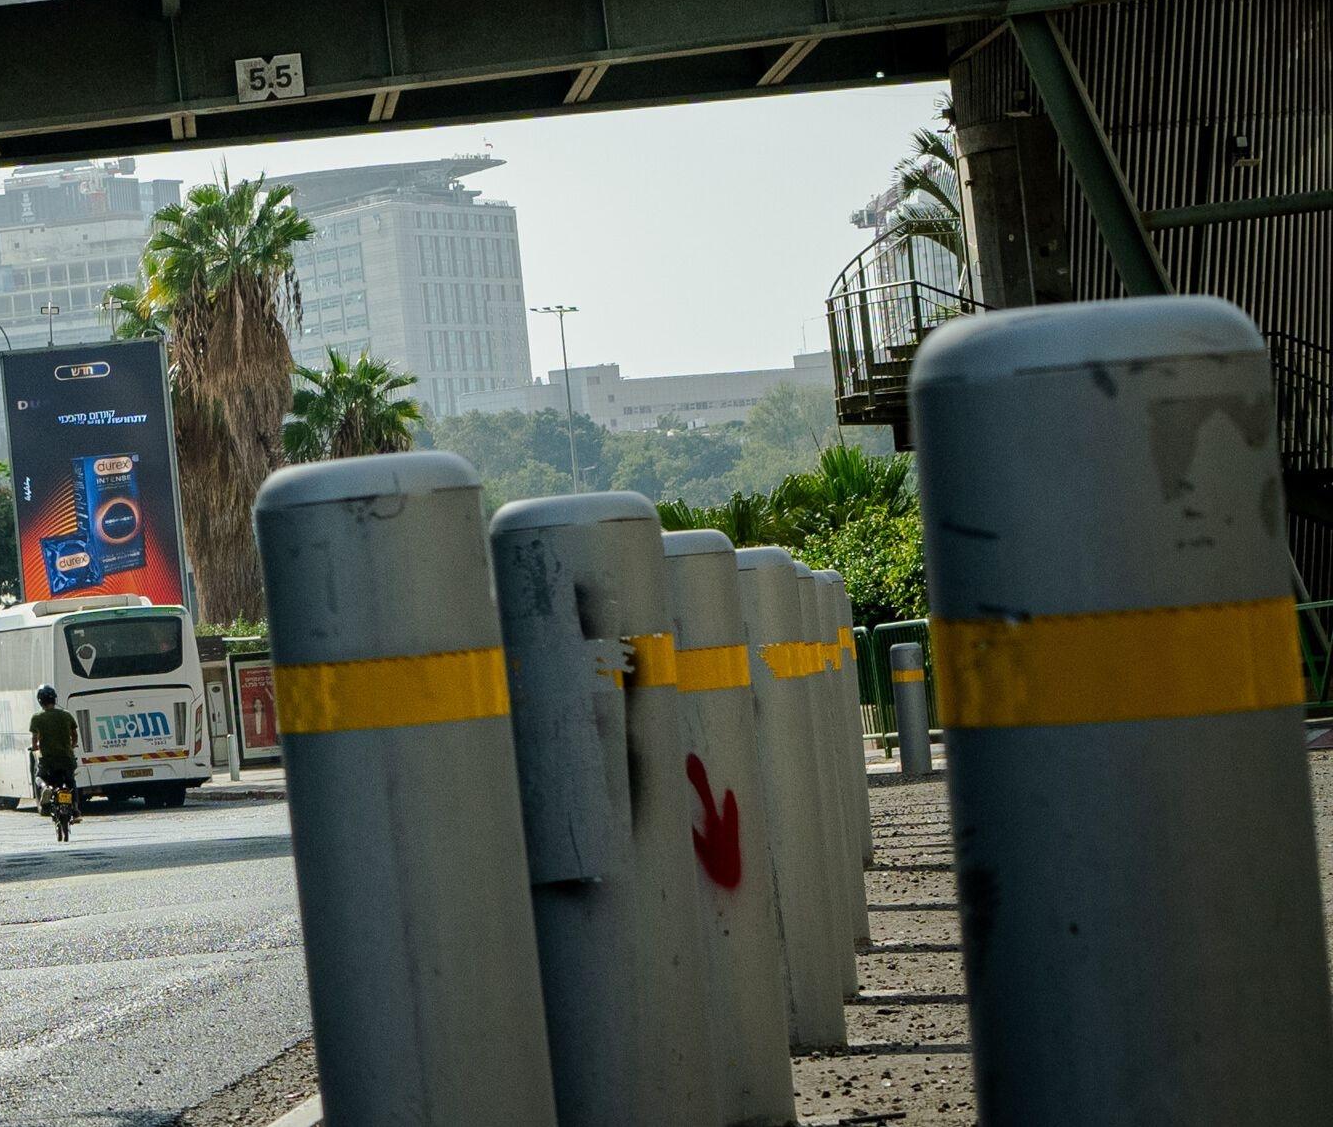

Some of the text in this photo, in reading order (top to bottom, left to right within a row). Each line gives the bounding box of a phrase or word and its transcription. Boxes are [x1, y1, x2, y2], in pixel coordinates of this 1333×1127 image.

[249, 64, 292, 91] 5.5
[70, 366, 93, 377] חדש
[97, 460, 129, 472] durex
[96, 474, 132, 485] INTENSE
[59, 554, 87, 569] durex
[95, 711, 171, 741] תנופה
